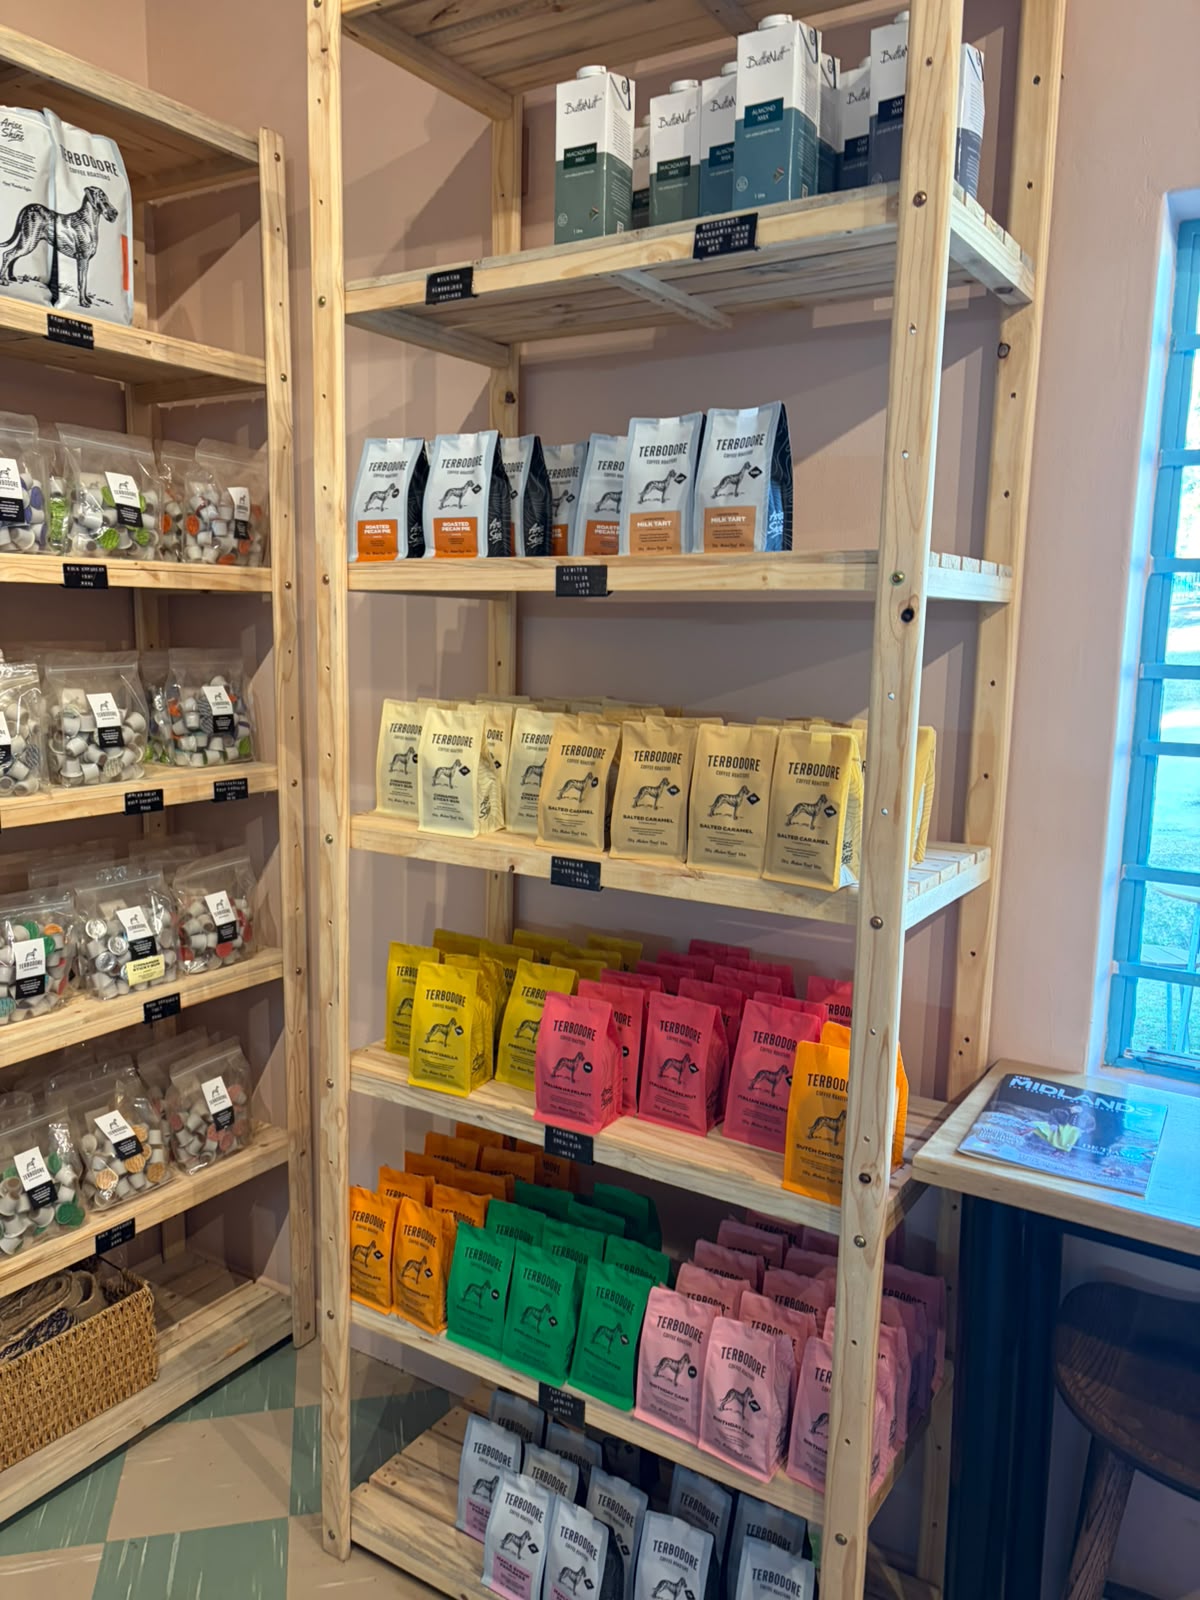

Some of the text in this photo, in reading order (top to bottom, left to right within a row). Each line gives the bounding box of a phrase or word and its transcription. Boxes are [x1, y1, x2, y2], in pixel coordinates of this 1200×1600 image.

[752, 104, 777, 116] ALMOND
[757, 112, 769, 121] MILK
[565, 147, 595, 158] MACADAMIA
[69, 167, 86, 176] COFFEE
[659, 160, 687, 171] MACADAMIA
[668, 167, 679, 175] MILK
[639, 443, 687, 458] TERBODORE
[716, 433, 765, 451] TERBODORE
[368, 460, 408, 472] TERBODORE
[441, 456, 483, 470] TERBODORE
[597, 460, 625, 471] TERBO
[728, 515, 746, 523] TART
[390, 723, 422, 736] TERBODOR
[432, 733, 473, 748] TERBODORE
[561, 745, 606, 760] TERBODORE
[634, 751, 682, 766] TERBODORE
[708, 755, 760, 772] TERBODORE
[788, 762, 840, 781] TERBODORE
[722, 827, 752, 835] CARAMEL
[777, 833, 829, 846] SALTED CARAMEL
[425, 989, 465, 1008] TERBODORE
[521, 986, 546, 1000] TERBO
[553, 1020, 596, 1042] TERBODORE
[660, 1020, 702, 1044] TERBODORE
[753, 1031, 797, 1051] TERBODOR
[418, 1048, 458, 1060] FRENCH VANILLA
[543, 1081, 592, 1097] ITALIAN HAZELNUT
[808, 1073, 848, 1093] TERBOD
[668, 1087, 696, 1099] HAZELNUT
[738, 1094, 759, 1103] ITALIAN
[816, 1090, 831, 1098] COFFEE
[1009, 1078, 1152, 1117] MIDLANDS
[796, 1143, 816, 1153] DUTCH
[351, 1210, 386, 1232] TERBODORE
[404, 1224, 437, 1248] TERBODORE
[464, 1246, 502, 1273] TERBODORE
[522, 1267, 561, 1296] TERBODORE
[595, 1287, 636, 1315] TERBODORE
[656, 1315, 703, 1345] TERBODORE
[662, 1332, 675, 1341] COFFEE
[720, 1346, 766, 1379] TERBODORE
[648, 1381, 688, 1402] BIRTHDAY CAKE
[713, 1415, 754, 1439] BIRTHDAY CAKE
[473, 1441, 512, 1468] TERBODORE
[532, 1466, 568, 1497] TERBODORE
[505, 1492, 545, 1523] TERBODORE
[598, 1494, 634, 1528] TERBODORE
[679, 1493, 720, 1528] TERBODORE
[560, 1526, 597, 1561] TERBODORE
[746, 1523, 792, 1552] TERBODORE
[653, 1539, 699, 1571] TERBODORE
[659, 1556, 672, 1565] COFFEE
[752, 1567, 802, 1598] TERBODORE
